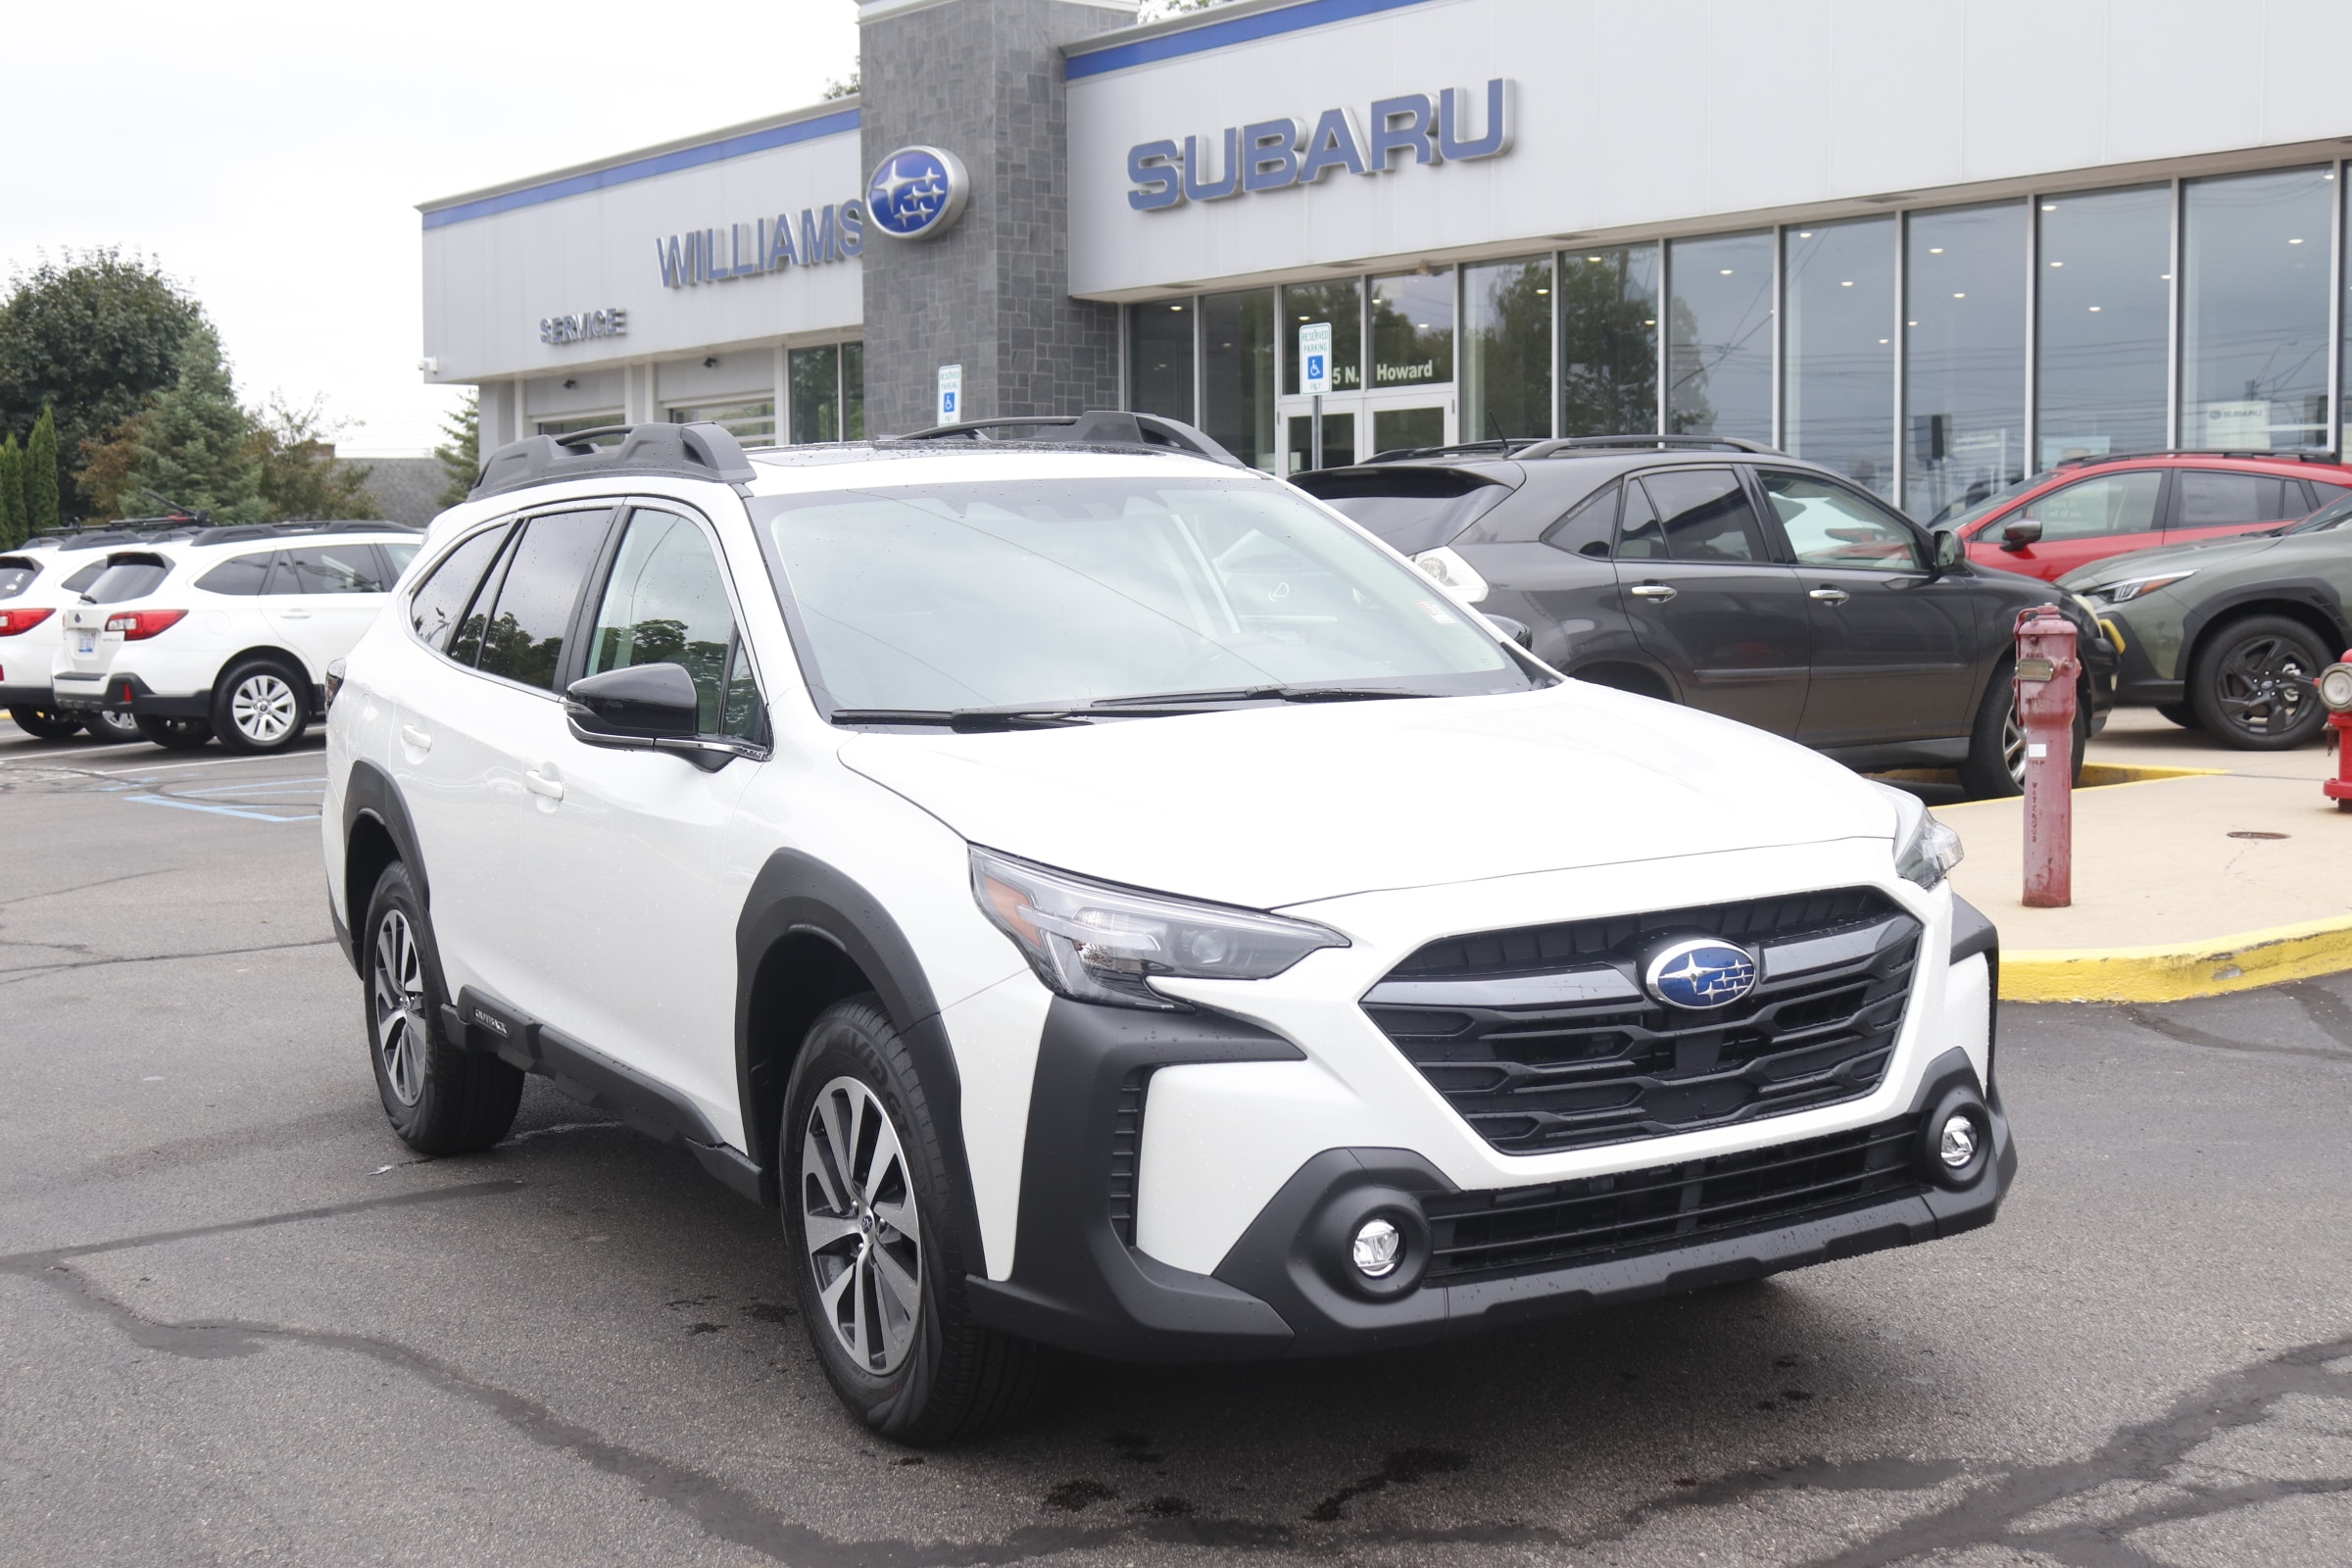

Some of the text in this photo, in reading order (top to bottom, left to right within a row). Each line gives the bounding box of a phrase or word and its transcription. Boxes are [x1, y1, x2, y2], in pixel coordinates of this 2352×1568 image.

[1127, 77, 1515, 211] SUBARU
[656, 199, 863, 288] WILLIAMS
[539, 308, 626, 344] SERVICE
[1301, 330, 1329, 341] RESERVED
[1303, 342, 1328, 353] PARKING
[1346, 366, 1360, 383] N.
[1375, 360, 1433, 381] Howard
